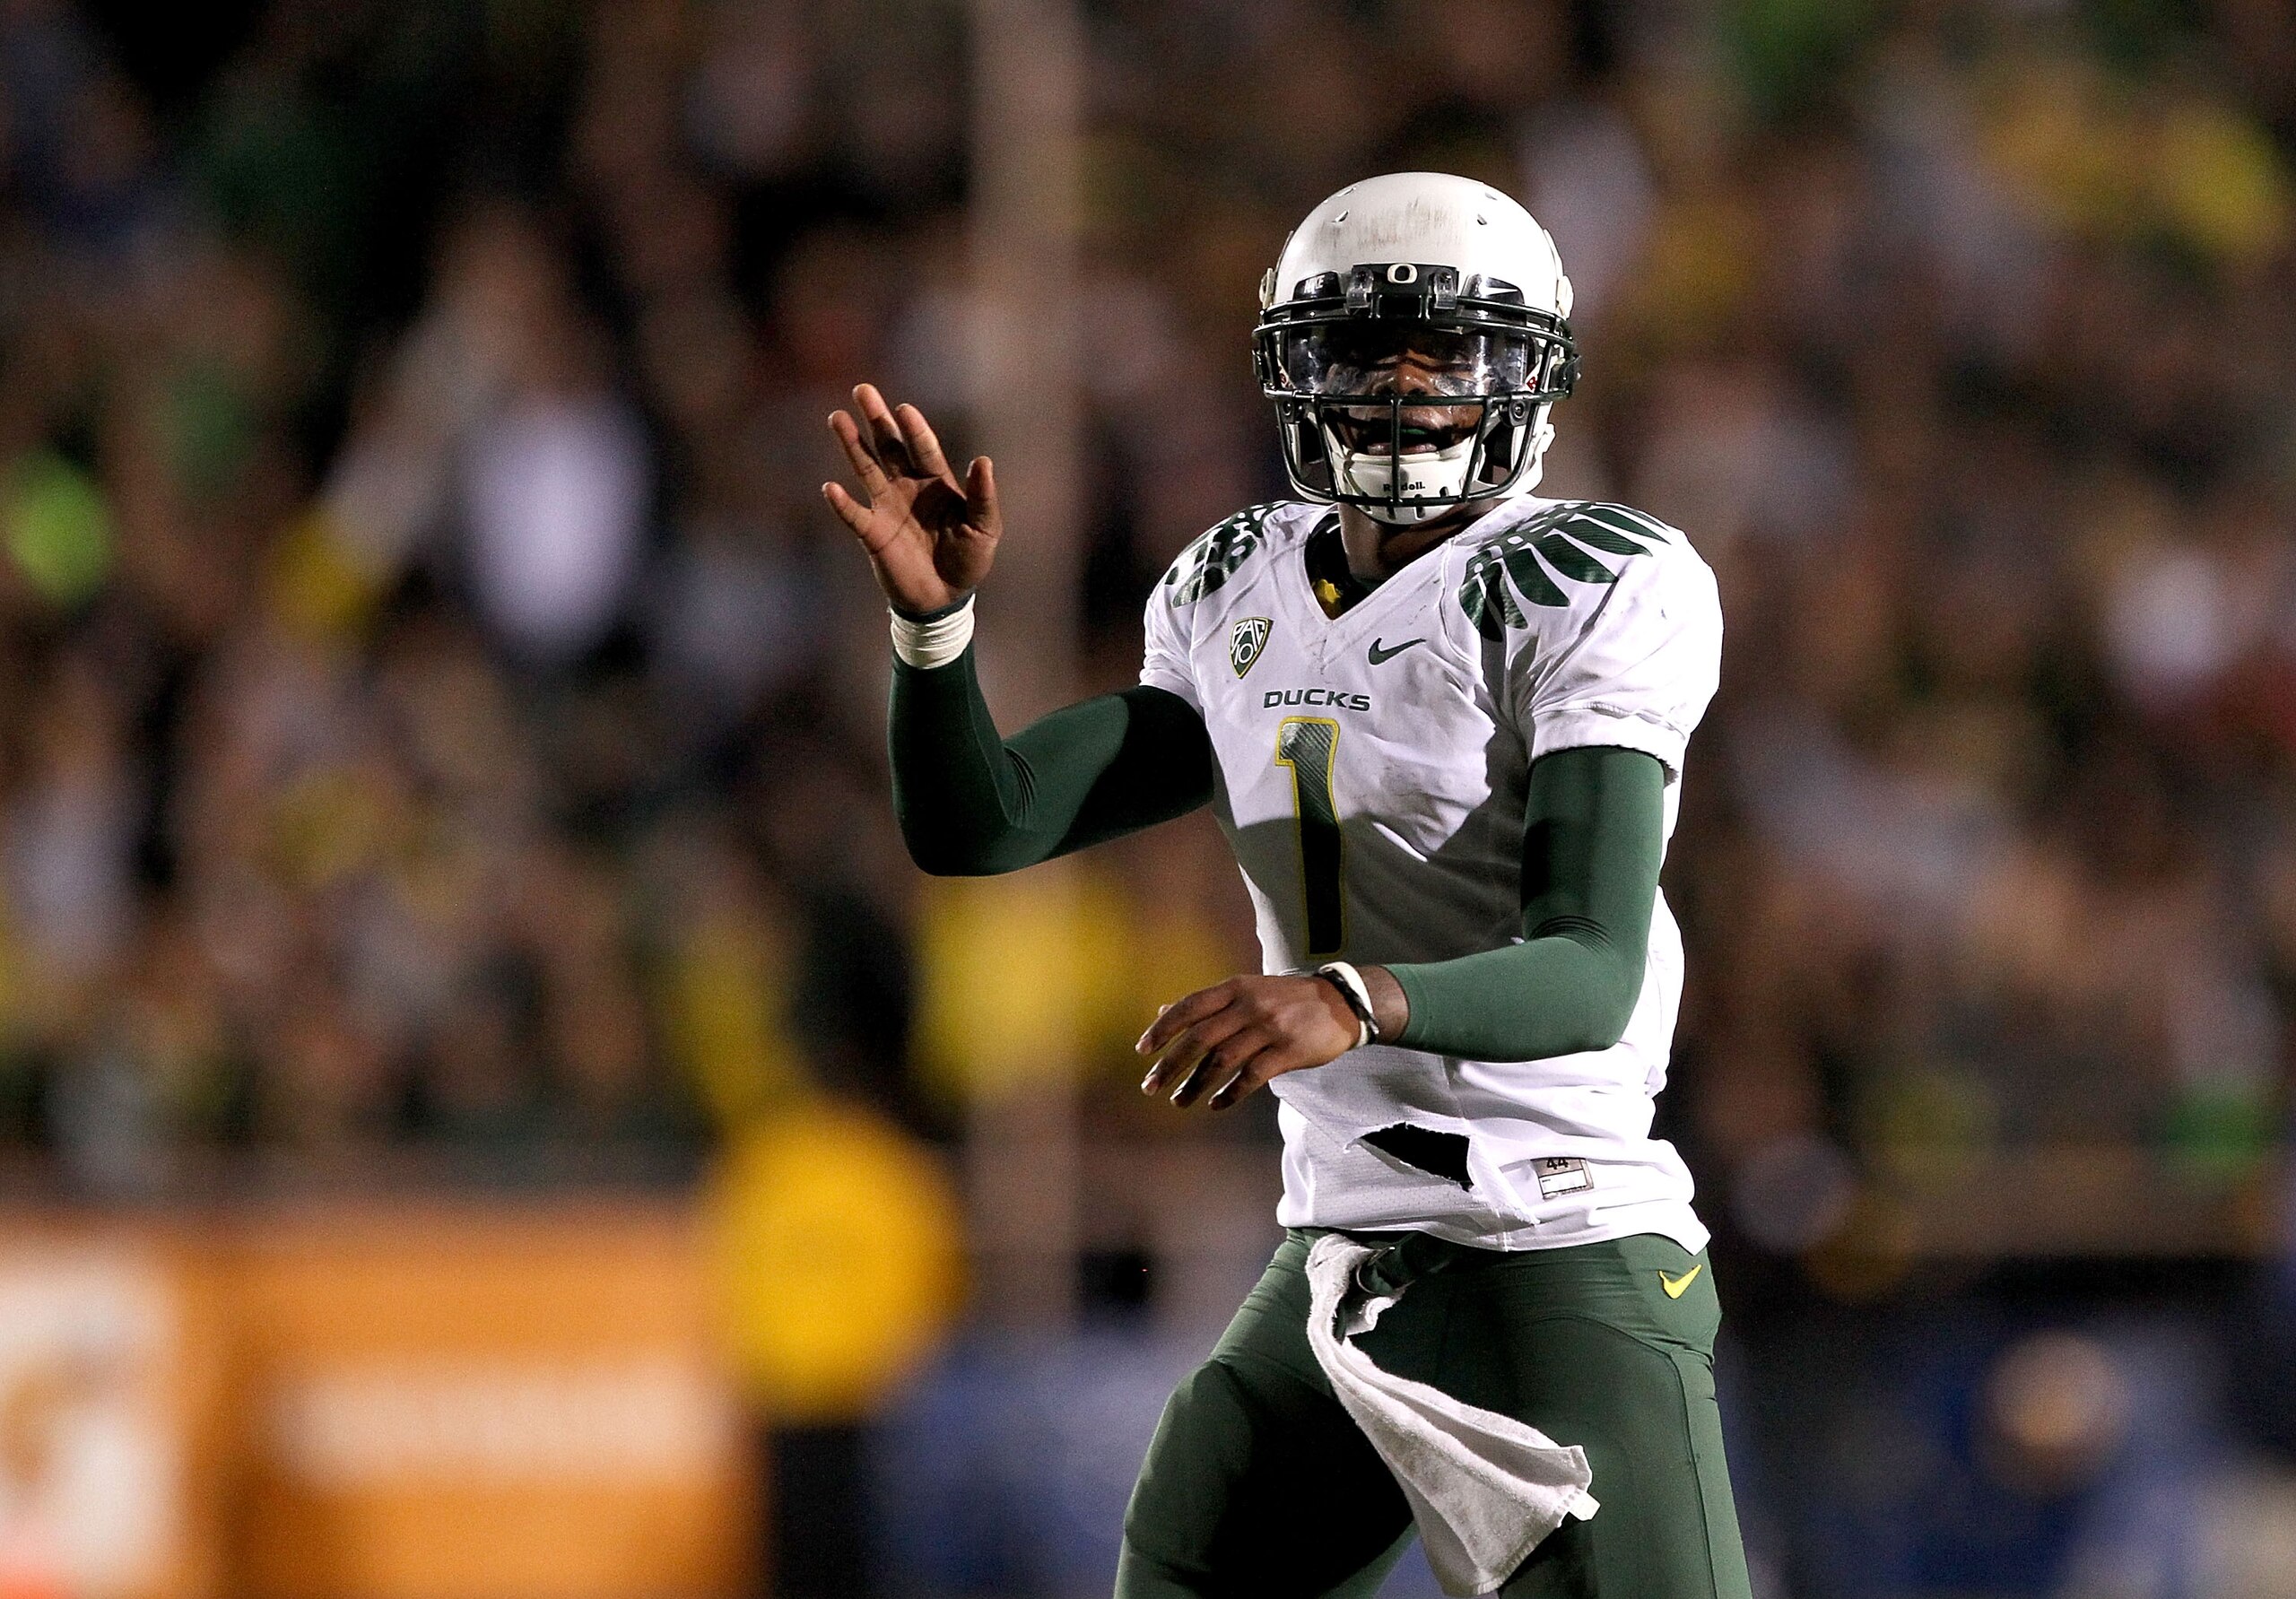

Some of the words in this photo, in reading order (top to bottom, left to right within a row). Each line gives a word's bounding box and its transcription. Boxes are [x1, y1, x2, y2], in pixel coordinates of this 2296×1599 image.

[1387, 263, 1418, 284] O
[1231, 620, 1265, 654] PAC
[1234, 643, 1254, 665] 10
[1263, 689, 1370, 711] DUCKS
[1274, 716, 1349, 960] 1
[1546, 1157, 1569, 1169] 44
